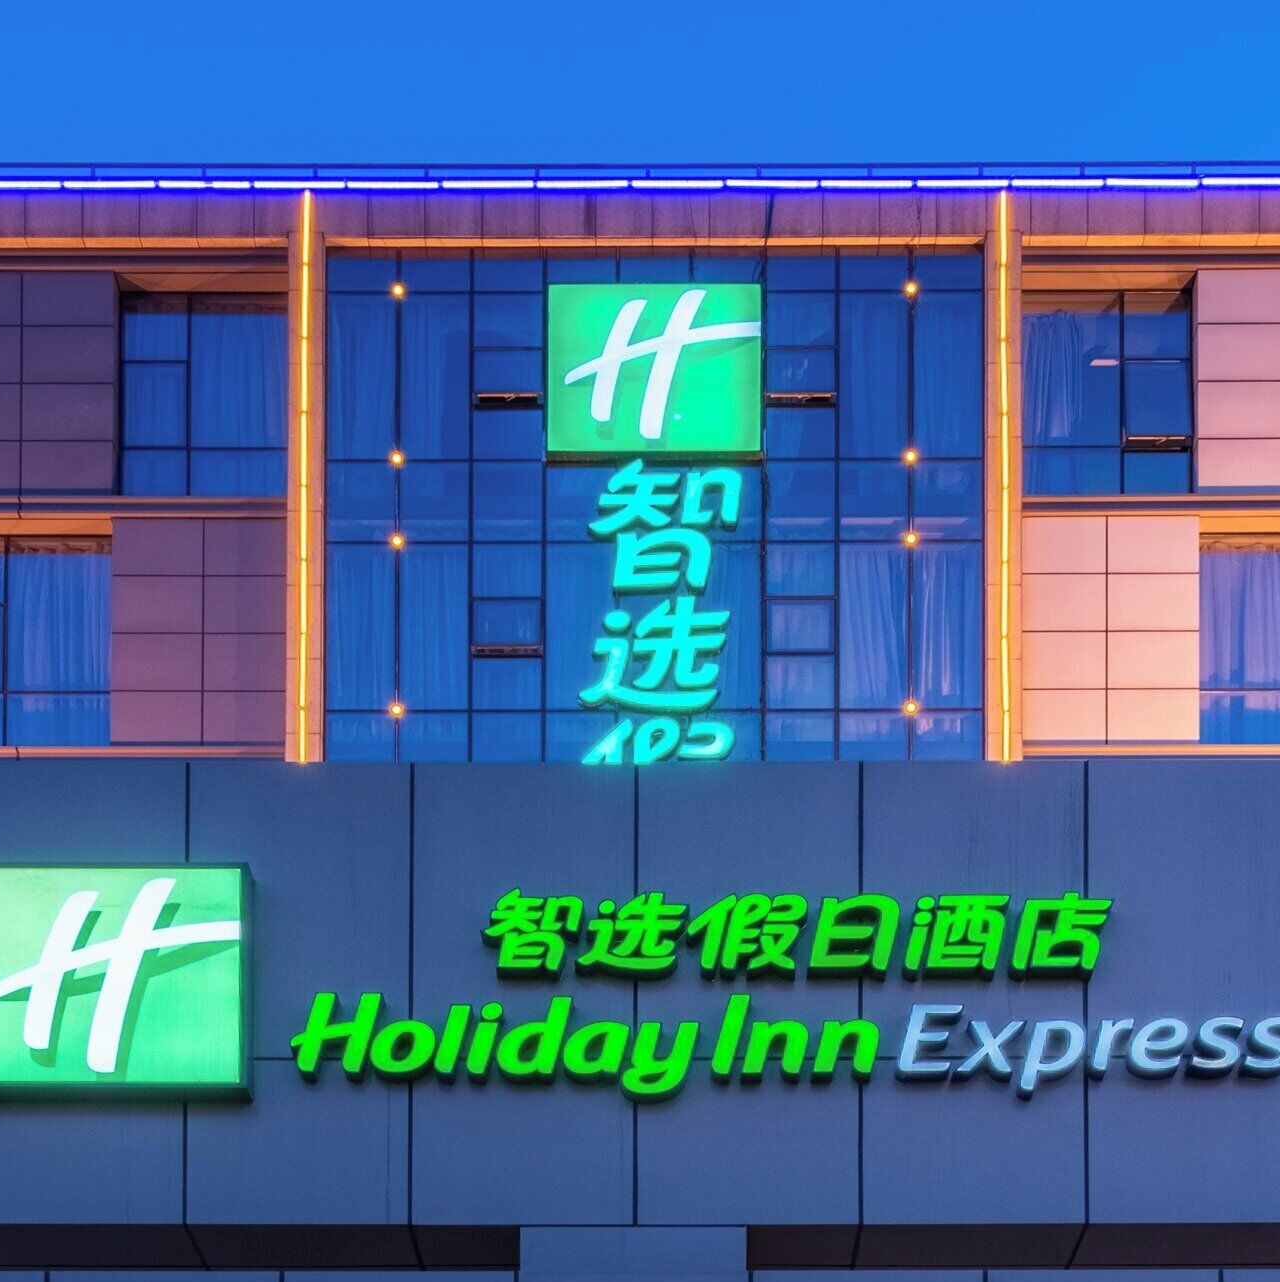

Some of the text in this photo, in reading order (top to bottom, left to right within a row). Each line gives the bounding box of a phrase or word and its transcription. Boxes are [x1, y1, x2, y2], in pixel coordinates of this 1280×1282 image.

[484, 886, 1113, 975] 智选假日酒店
[290, 992, 699, 1096] Holiday
[710, 994, 881, 1078] Inn
